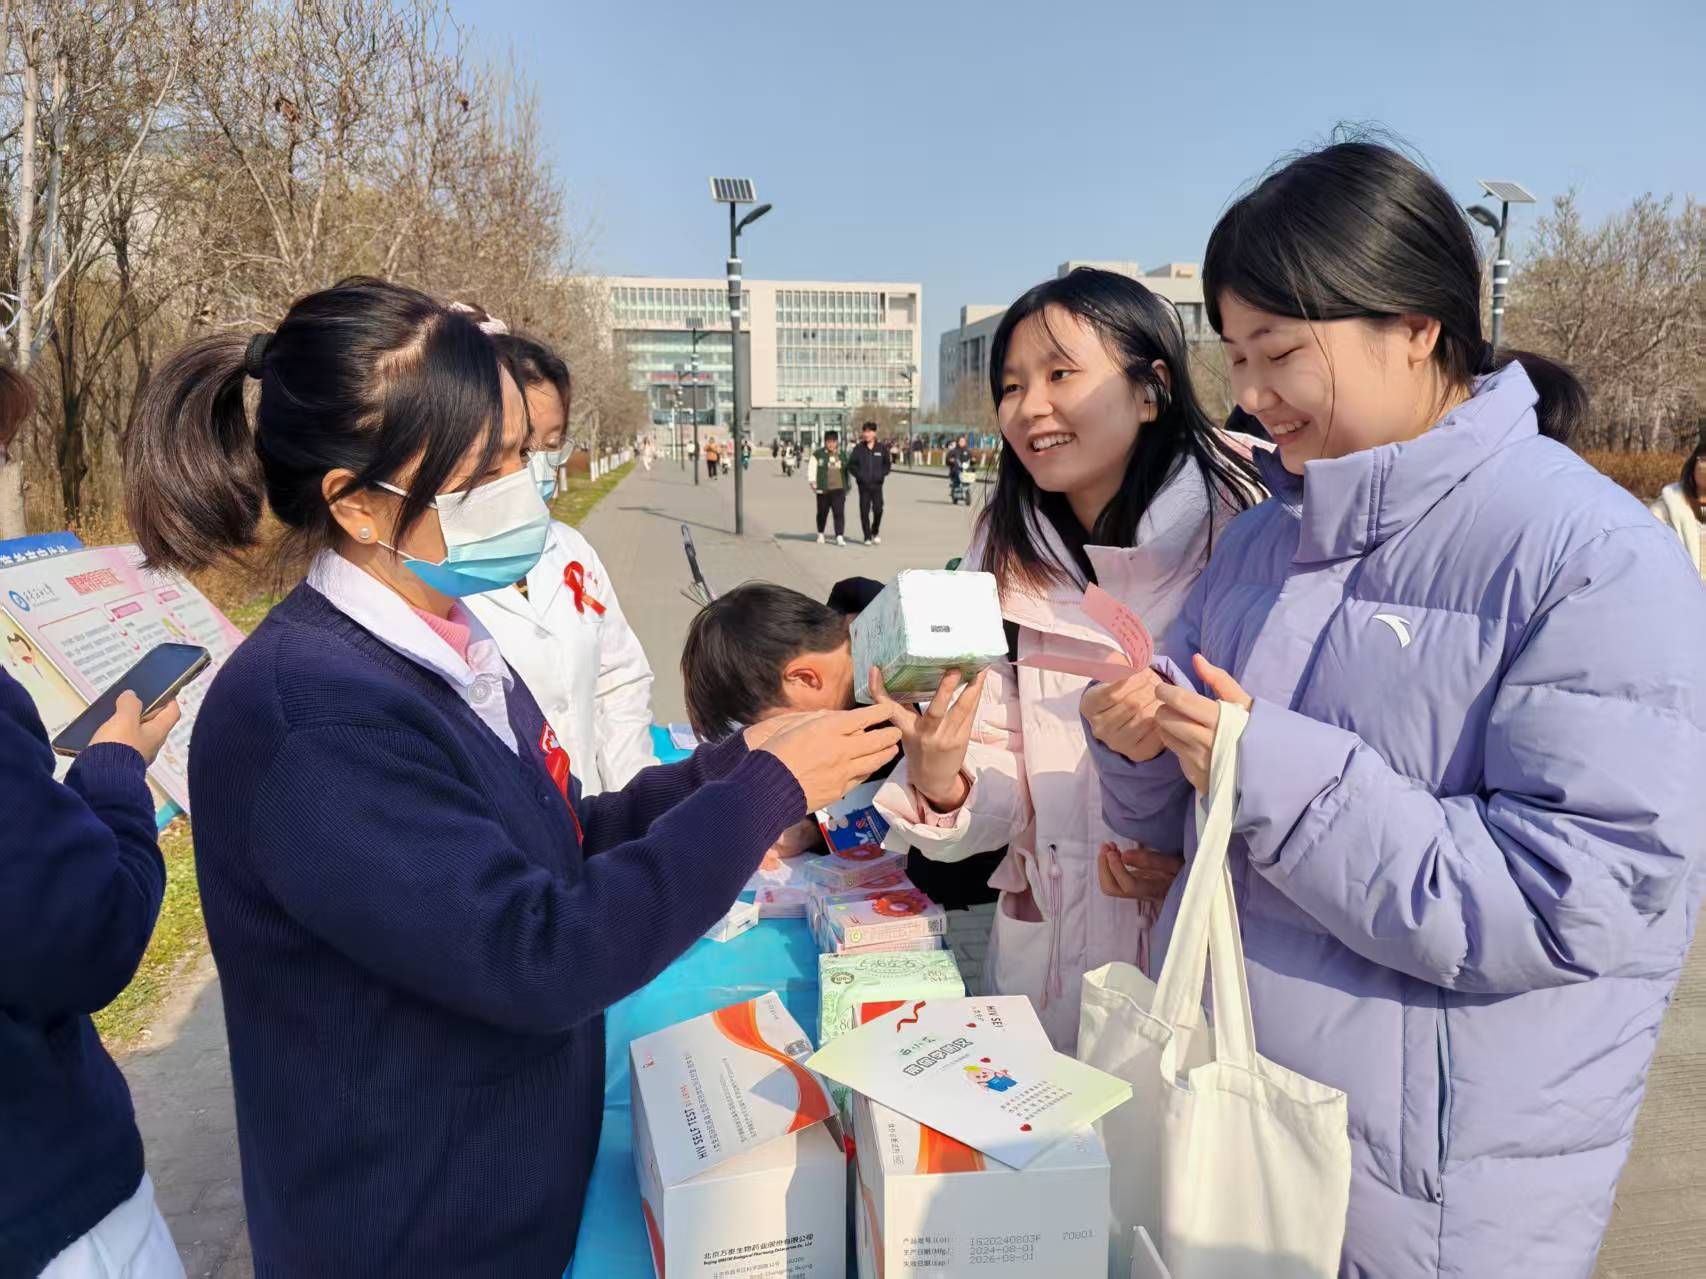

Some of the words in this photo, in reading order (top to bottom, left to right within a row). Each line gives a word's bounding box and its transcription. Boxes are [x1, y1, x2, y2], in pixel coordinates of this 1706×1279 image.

[684, 1108, 697, 1127] TEST
[690, 1127, 704, 1146] SELF
[695, 1146, 708, 1160] HIV
